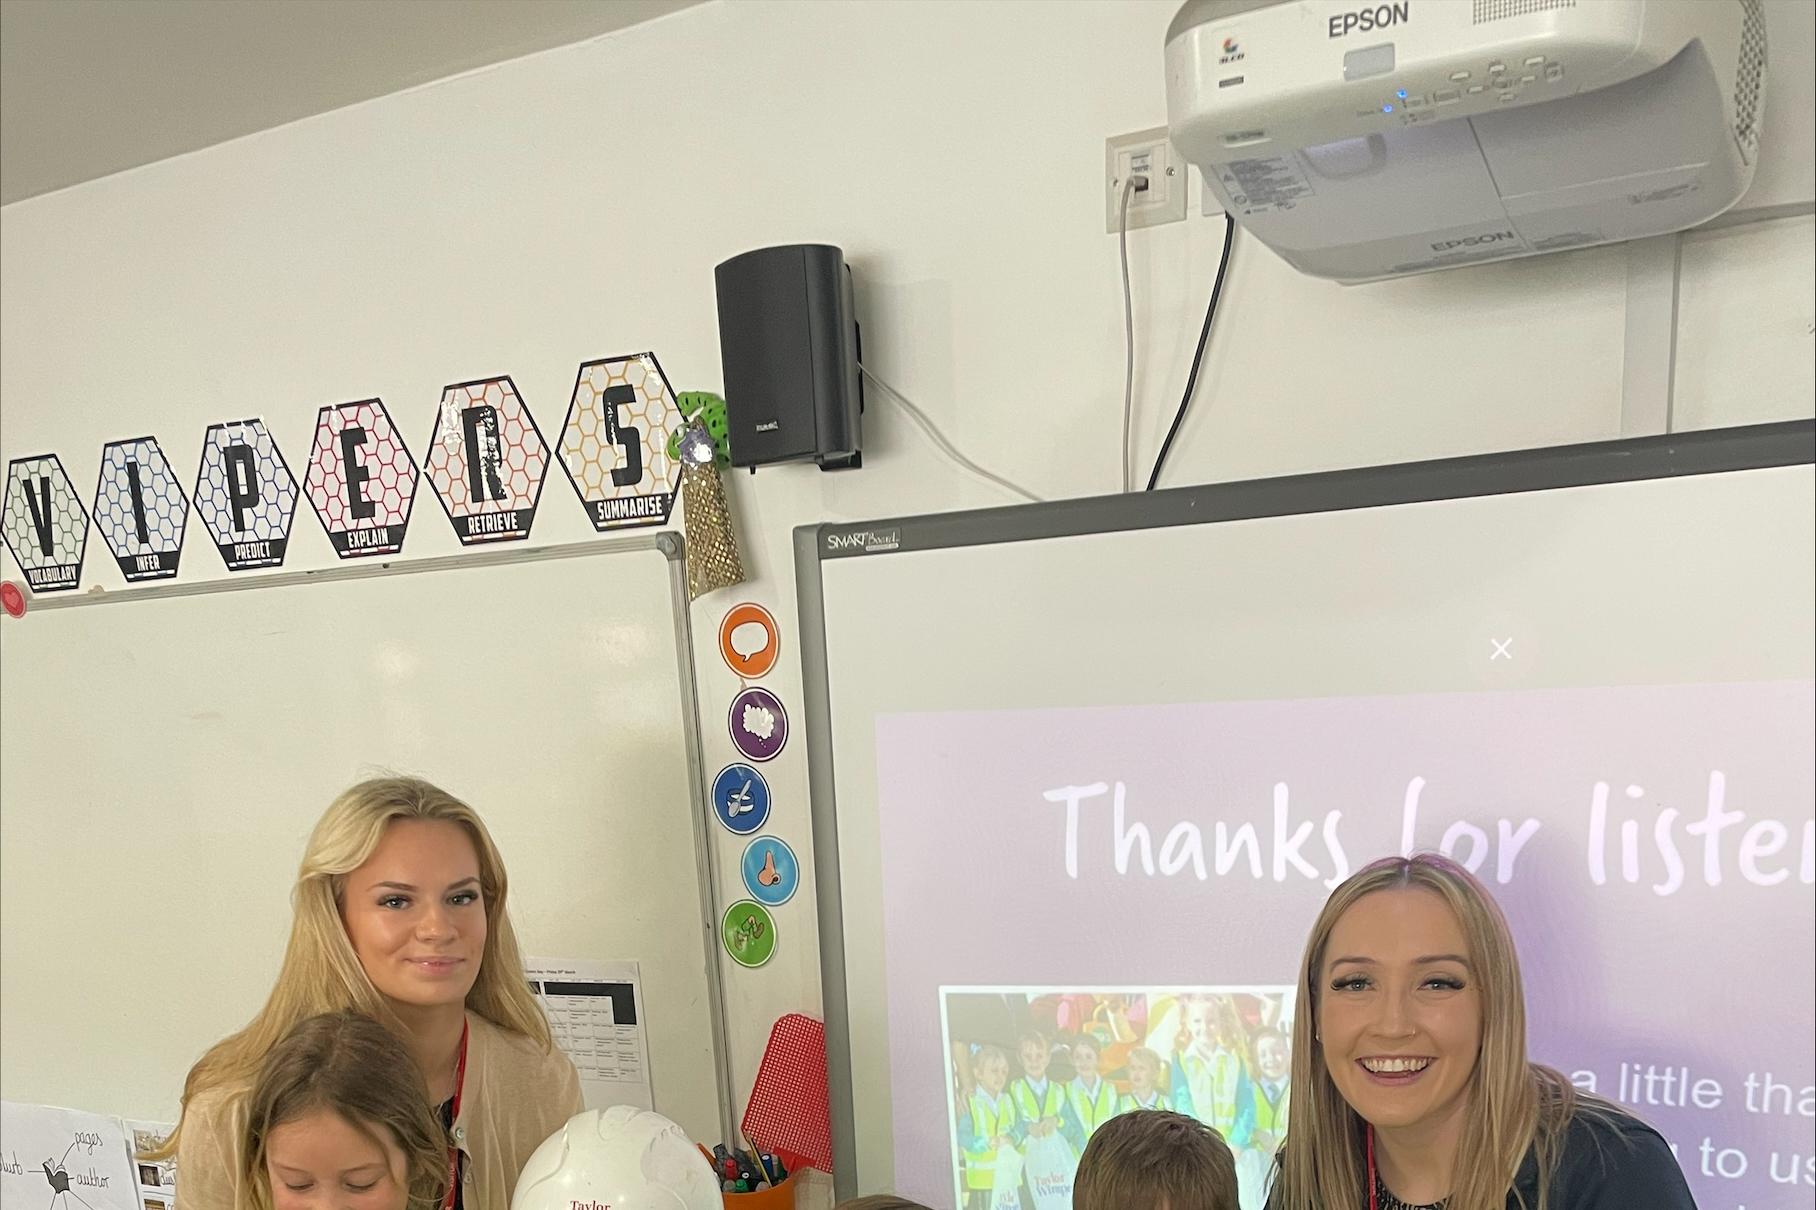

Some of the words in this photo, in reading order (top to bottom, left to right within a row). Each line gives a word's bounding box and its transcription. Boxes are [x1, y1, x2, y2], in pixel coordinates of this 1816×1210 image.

[1329, 1, 1409, 39] EPSON
[1430, 230, 1514, 252] EPSON
[597, 496, 662, 521] SUMMARISE
[467, 511, 518, 534] RETRIEVE
[347, 528, 389, 549] EXPLAIN
[828, 532, 868, 550] SMART
[135, 554, 161, 571] INFER
[234, 542, 271, 561] PREDICT
[28, 566, 77, 584] VOCABULARY
[1043, 781, 1348, 890] Thanks
[1588, 769, 1815, 897] liste
[1619, 1062, 1724, 1110] little
[74, 1132, 103, 1156] pages
[1699, 1136, 1749, 1179] to
[76, 1167, 110, 1188] author
